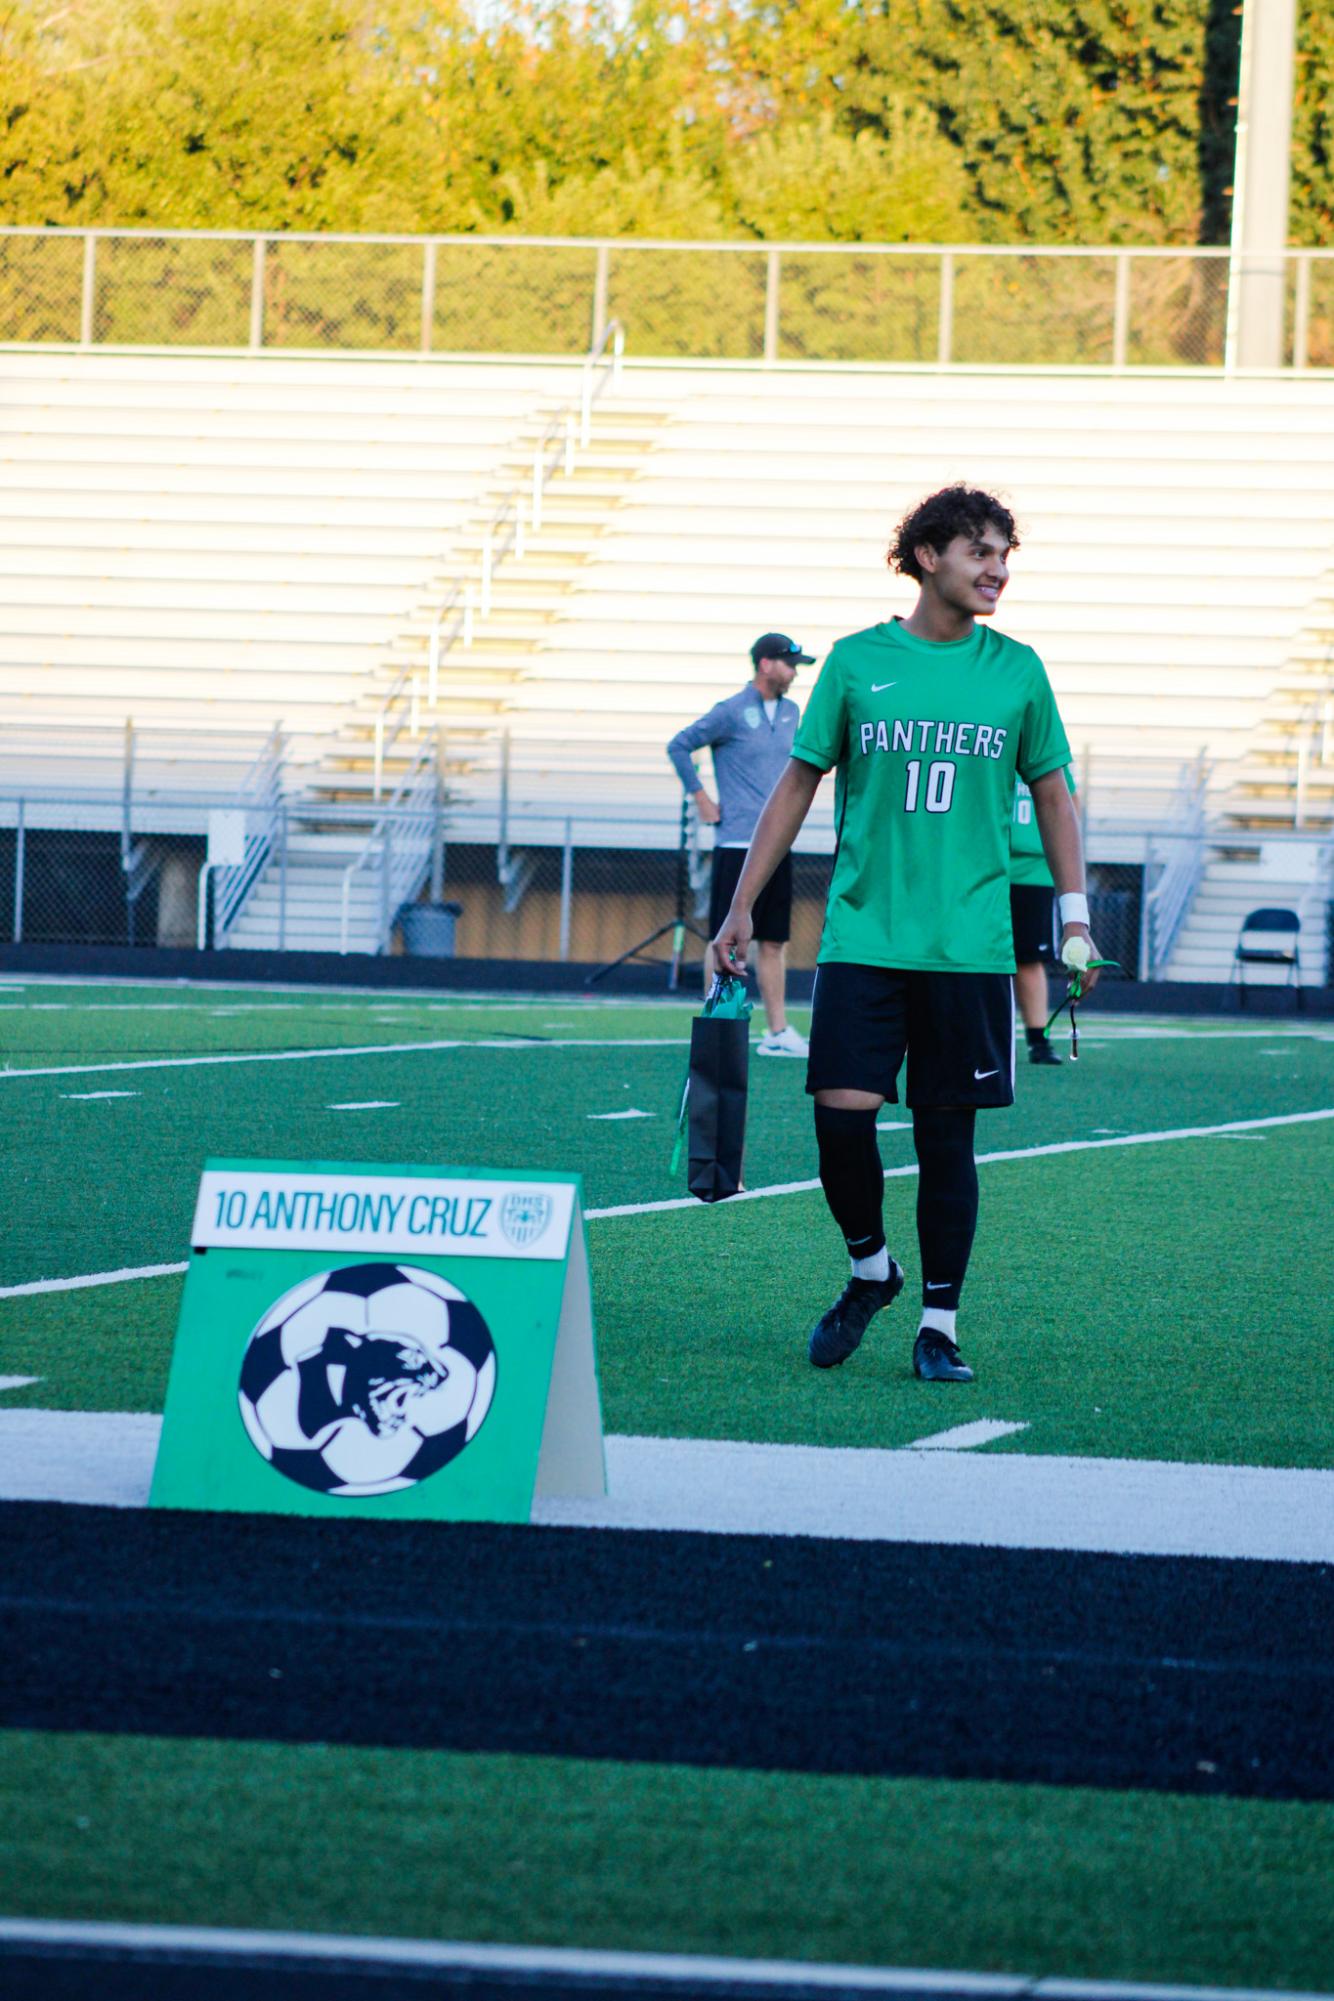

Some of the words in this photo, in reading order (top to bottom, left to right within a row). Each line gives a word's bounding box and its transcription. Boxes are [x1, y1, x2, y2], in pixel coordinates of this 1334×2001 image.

[860, 719, 1007, 760] PANTHERS
[904, 759, 957, 813] 10
[216, 1191, 247, 1229] 10
[249, 1191, 406, 1233] ANTHONY
[408, 1195, 493, 1237] CRUZ
